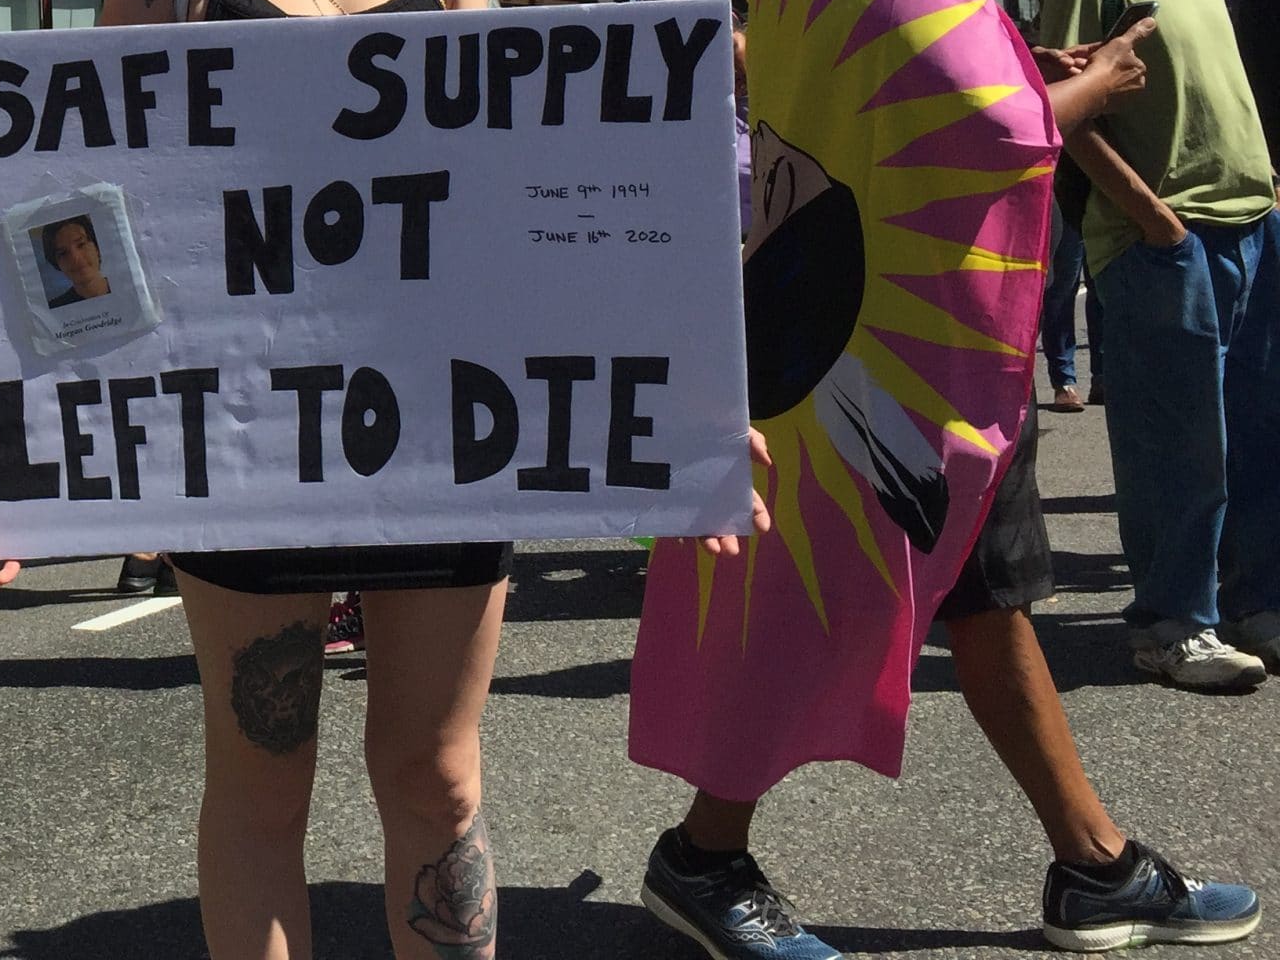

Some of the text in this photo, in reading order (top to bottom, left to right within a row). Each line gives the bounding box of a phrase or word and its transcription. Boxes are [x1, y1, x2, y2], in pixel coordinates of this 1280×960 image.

[333, 17, 722, 142] SUPPLY
[224, 171, 449, 297] NOT
[525, 183, 650, 198] JUNE 9th 1994
[528, 229, 672, 243] JUNE 16th 2020
[271, 364, 401, 484] TO
[451, 356, 670, 494] DIE
